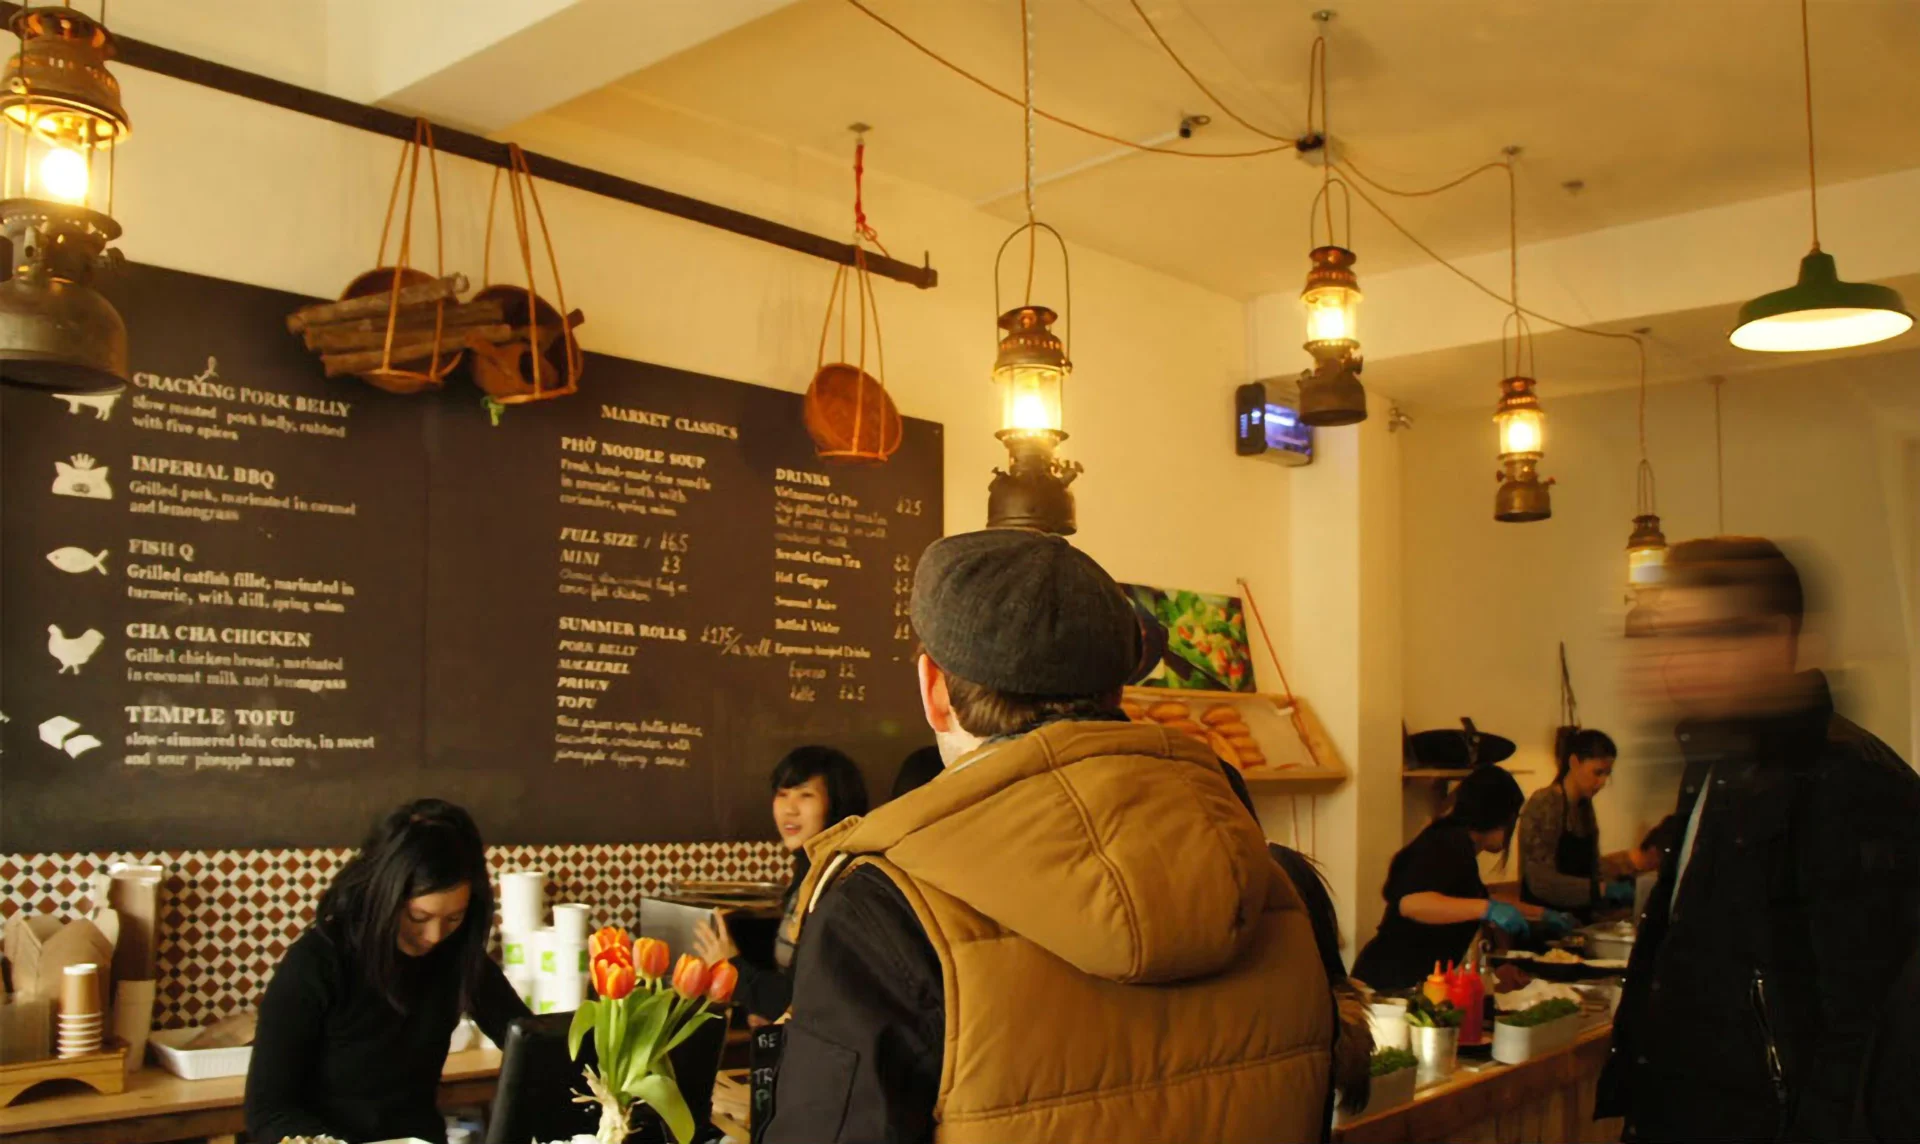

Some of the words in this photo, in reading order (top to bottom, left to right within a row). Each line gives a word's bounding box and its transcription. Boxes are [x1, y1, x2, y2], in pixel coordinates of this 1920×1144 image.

[133, 372, 235, 401] CRACKING
[240, 388, 292, 409] PORK
[295, 394, 352, 417] BELLY
[133, 414, 163, 430] with
[167, 418, 194, 435] five
[197, 423, 239, 441] spices
[226, 411, 255, 426] pork
[601, 405, 670, 429] MARKET
[675, 417, 739, 440] CLASSICS
[601, 443, 664, 464] NOODLE
[669, 453, 706, 469] SOUP
[132, 455, 229, 481] IMPERIAL
[234, 466, 276, 489] BBQ
[775, 468, 831, 487] DRINKS
[130, 481, 178, 498] Grilled
[221, 492, 290, 509] marinated
[294, 496, 308, 510] in
[130, 500, 156, 514] and
[158, 500, 240, 522] lemongrass
[560, 527, 600, 544] FULL
[603, 531, 639, 548] SIZE
[129, 539, 174, 558] FISH
[179, 544, 195, 561] Q
[560, 549, 601, 567] MINI
[127, 564, 181, 583] Grilled
[183, 569, 230, 587] catfish
[274, 578, 339, 595] marinated
[342, 581, 355, 595] in
[797, 573, 829, 590] Ginger
[198, 588, 234, 607] with
[273, 595, 311, 613] spring
[126, 623, 170, 641] CHA
[174, 625, 219, 643] CHA
[221, 627, 313, 649] CHICKEN
[559, 616, 635, 637] SUMMER
[640, 624, 687, 642] ROLLS
[810, 619, 841, 635] Water
[125, 648, 175, 665] Grilled
[178, 649, 232, 666] chicken
[283, 656, 343, 671] marinated
[598, 642, 639, 657] BELLY
[557, 658, 631, 675] MACKEREL
[127, 667, 142, 682] in
[143, 669, 201, 684] coconut
[206, 671, 239, 687] milk
[243, 673, 271, 688] and
[273, 674, 347, 692] lemongrass
[556, 695, 597, 710] TOFU
[125, 706, 225, 726] TEMPLE
[234, 709, 295, 726] TOFU
[125, 733, 236, 749] slow-simmered
[238, 734, 267, 749] tofu
[319, 734, 334, 749] in
[336, 736, 376, 750] sweet
[125, 752, 150, 767] and
[156, 755, 188, 767] sour
[195, 752, 253, 770] pineapple
[258, 754, 296, 768] sauce
